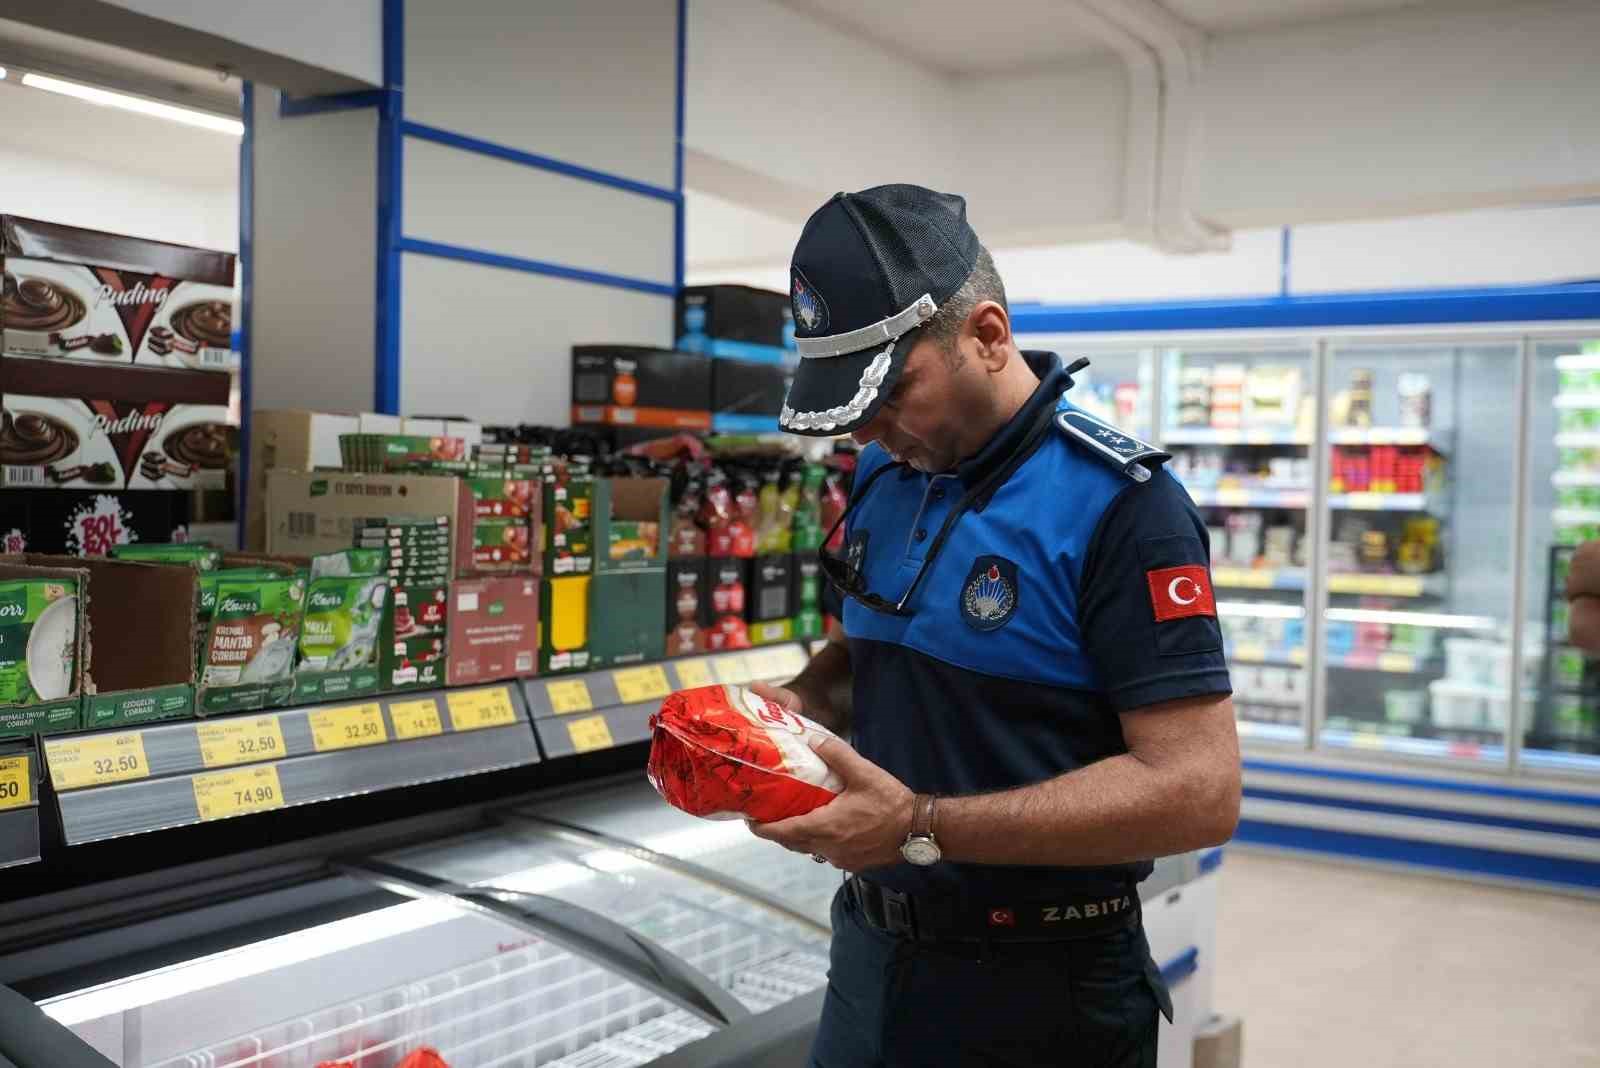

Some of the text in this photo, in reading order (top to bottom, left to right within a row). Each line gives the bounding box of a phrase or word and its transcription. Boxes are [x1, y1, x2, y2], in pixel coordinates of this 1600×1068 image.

[95, 281, 169, 311] Puding
[89, 408, 164, 440] Puding
[220, 598, 257, 612] Knorr
[213, 635, 254, 649] MANTAR
[1042, 896, 1130, 921] ZABITA
